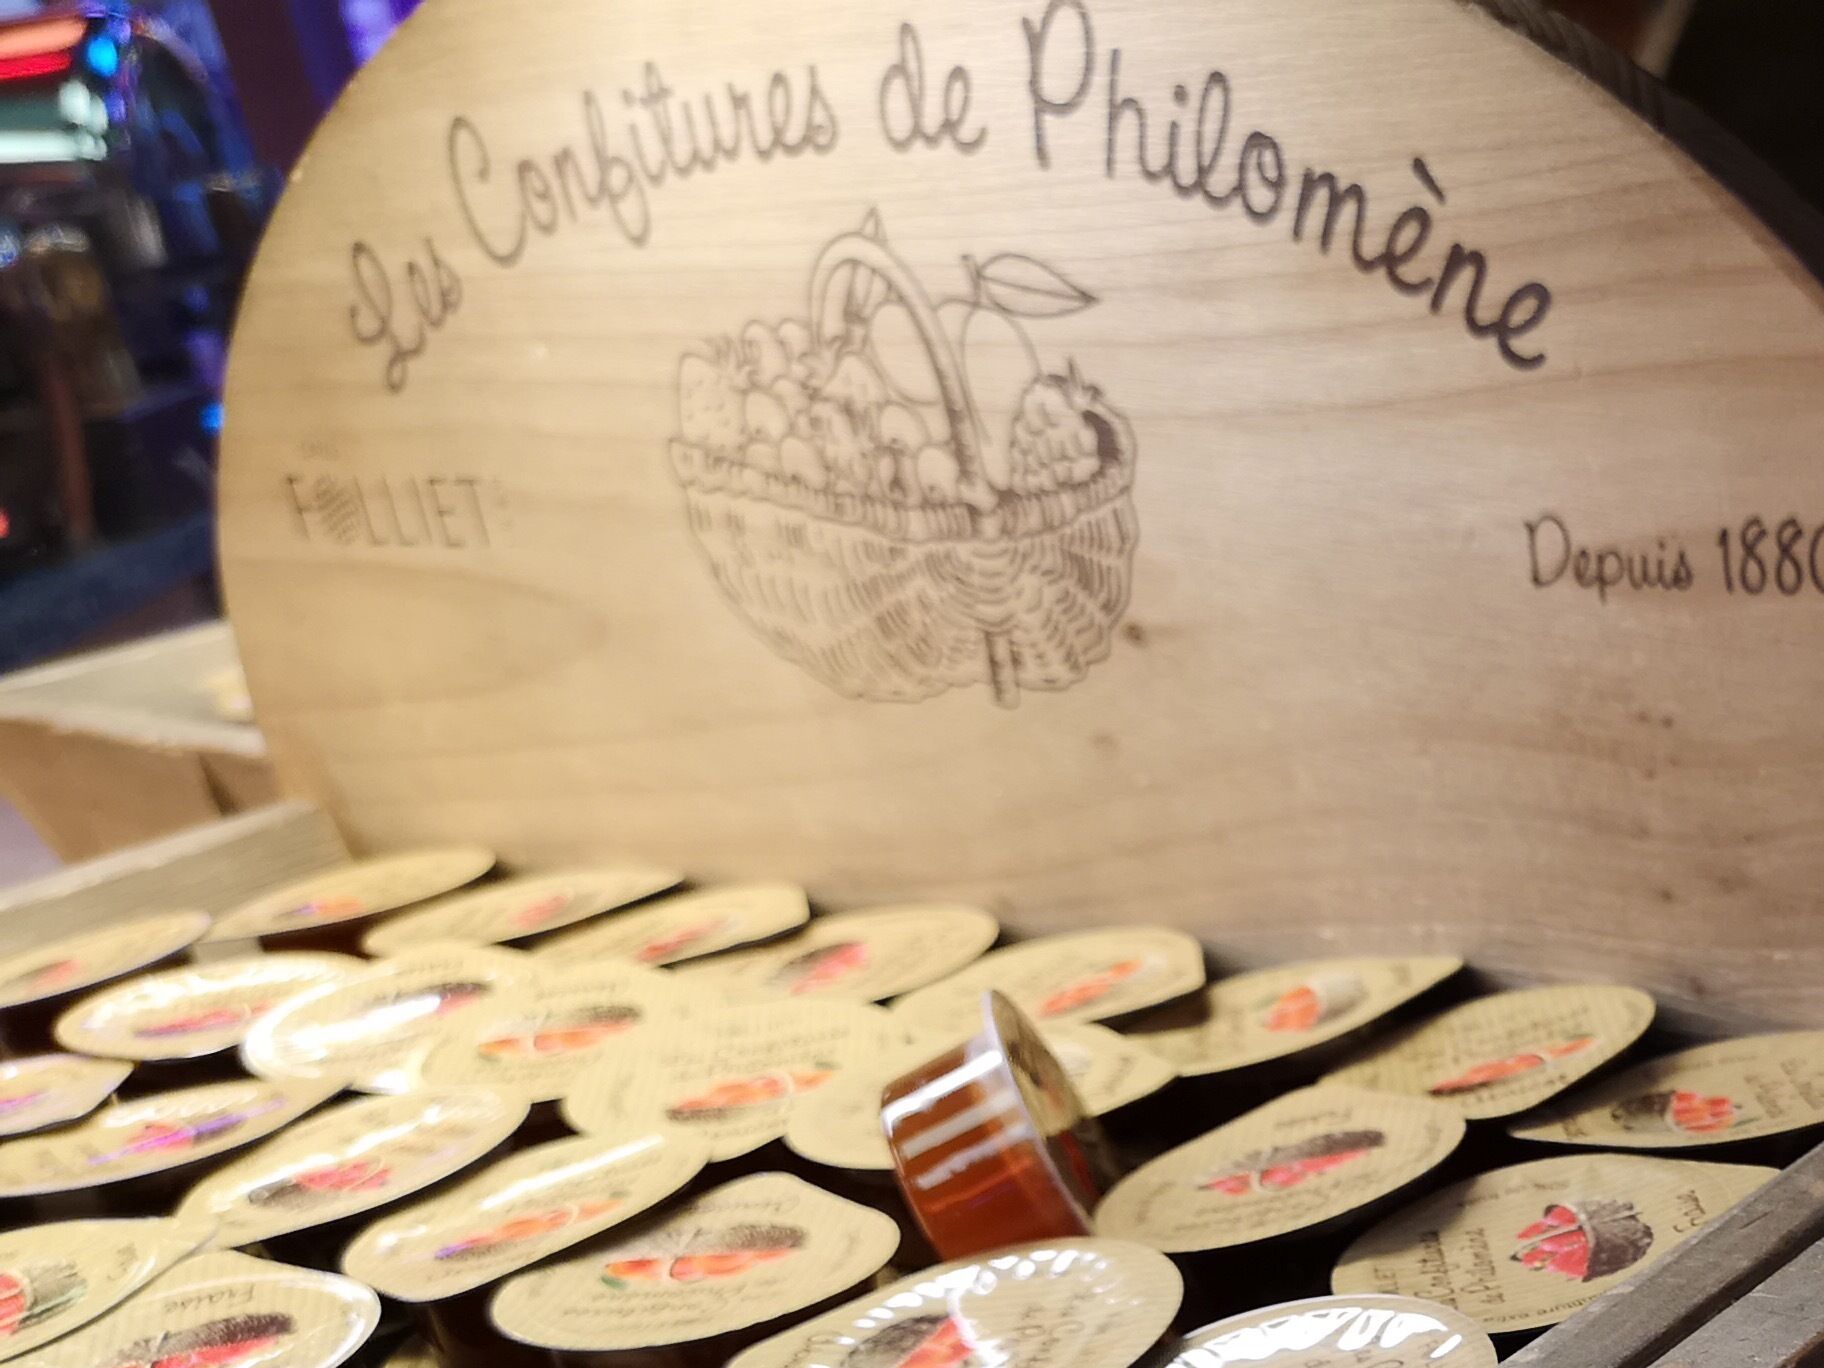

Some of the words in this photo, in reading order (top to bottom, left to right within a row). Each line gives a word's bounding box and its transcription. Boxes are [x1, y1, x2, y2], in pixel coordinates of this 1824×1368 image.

[350, 240, 461, 393] Les
[447, 60, 840, 268] Confitures
[878, 21, 987, 153] de
[1021, 0, 1553, 370] Philomène
[1523, 514, 1694, 604] Depuis
